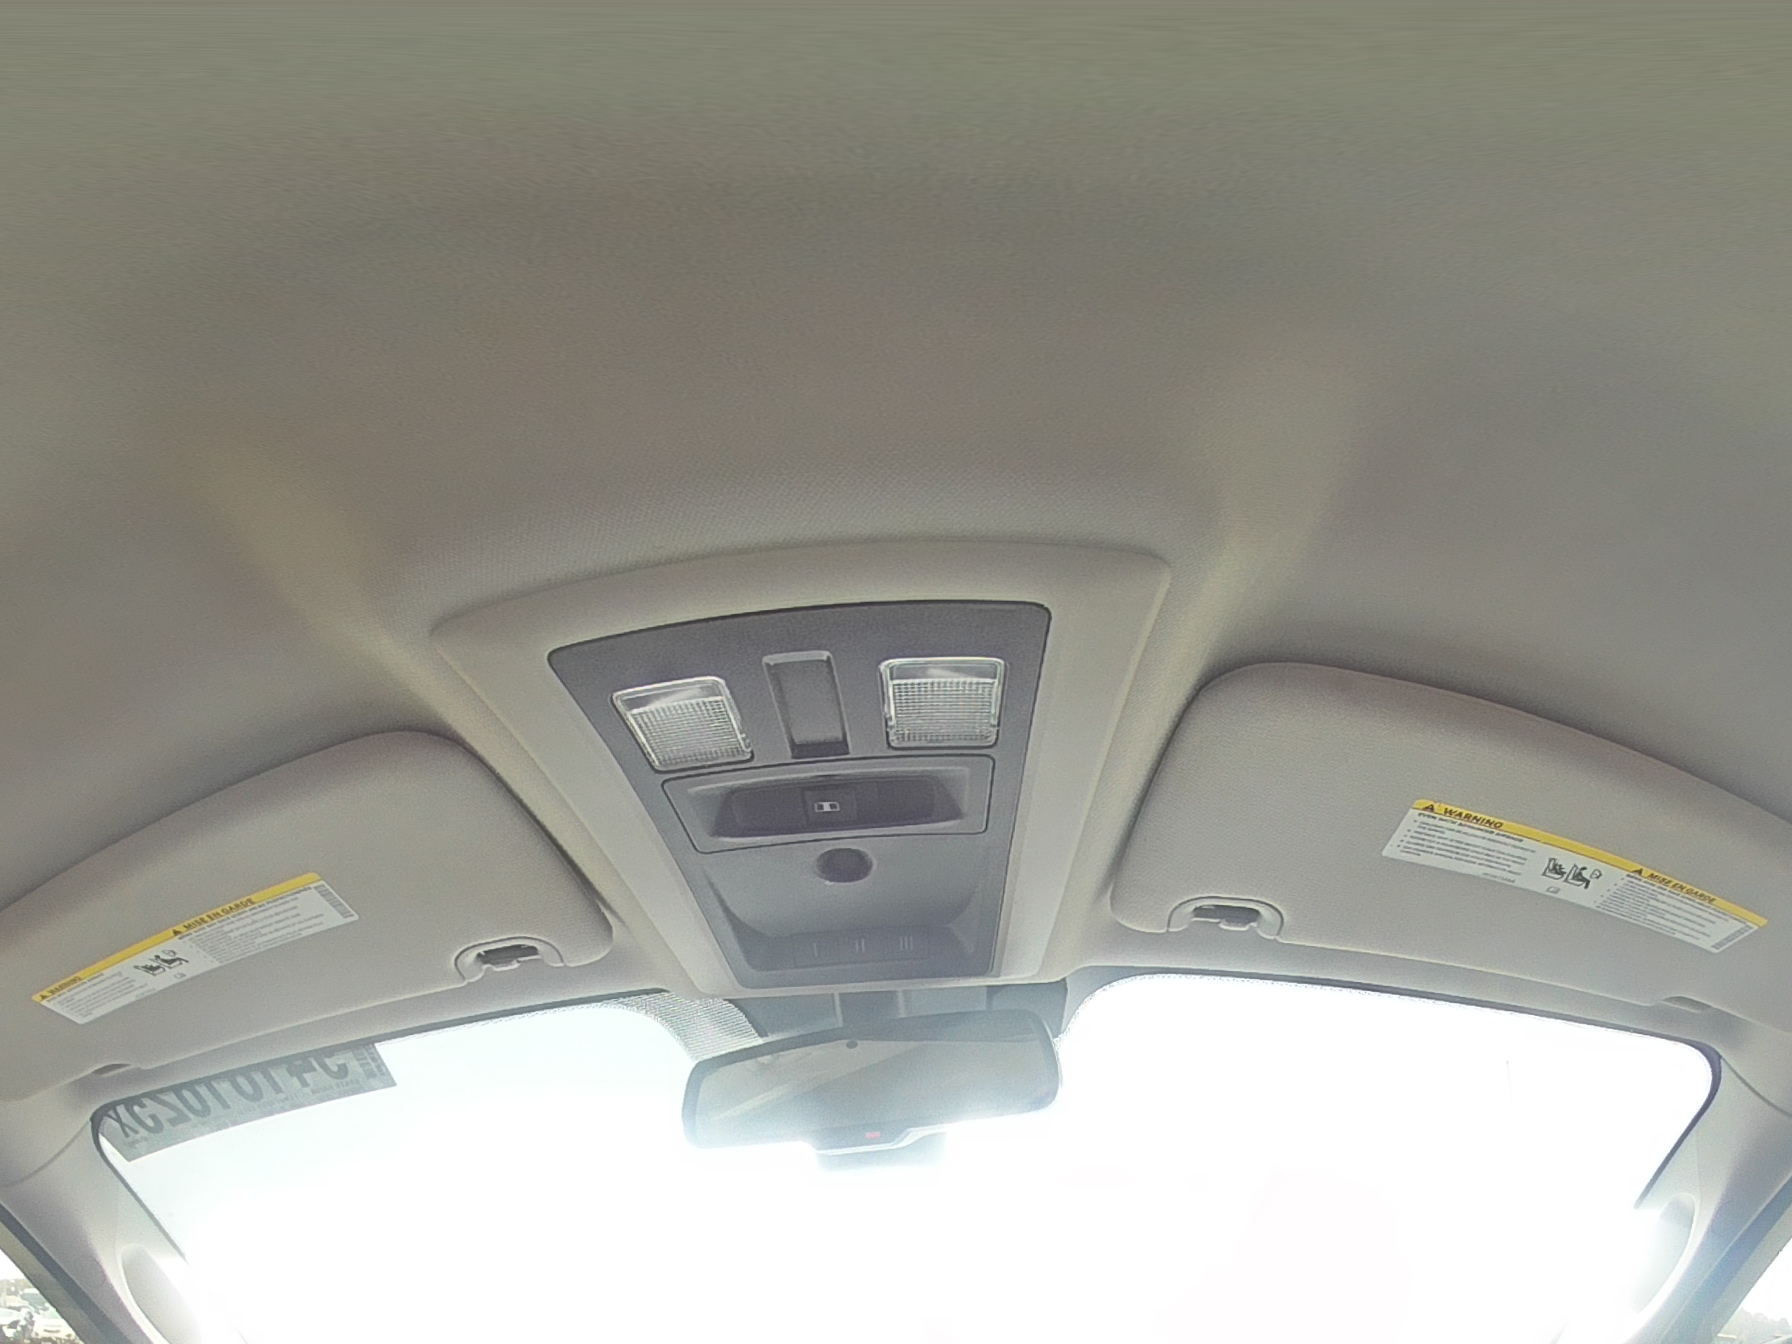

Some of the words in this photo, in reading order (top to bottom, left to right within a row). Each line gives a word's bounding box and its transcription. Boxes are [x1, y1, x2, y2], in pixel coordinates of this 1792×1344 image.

[1443, 807, 1503, 829] WARNING
[1648, 872, 1671, 888] MISE
[183, 916, 207, 931] MISE
[221, 898, 257, 917] GARDE
